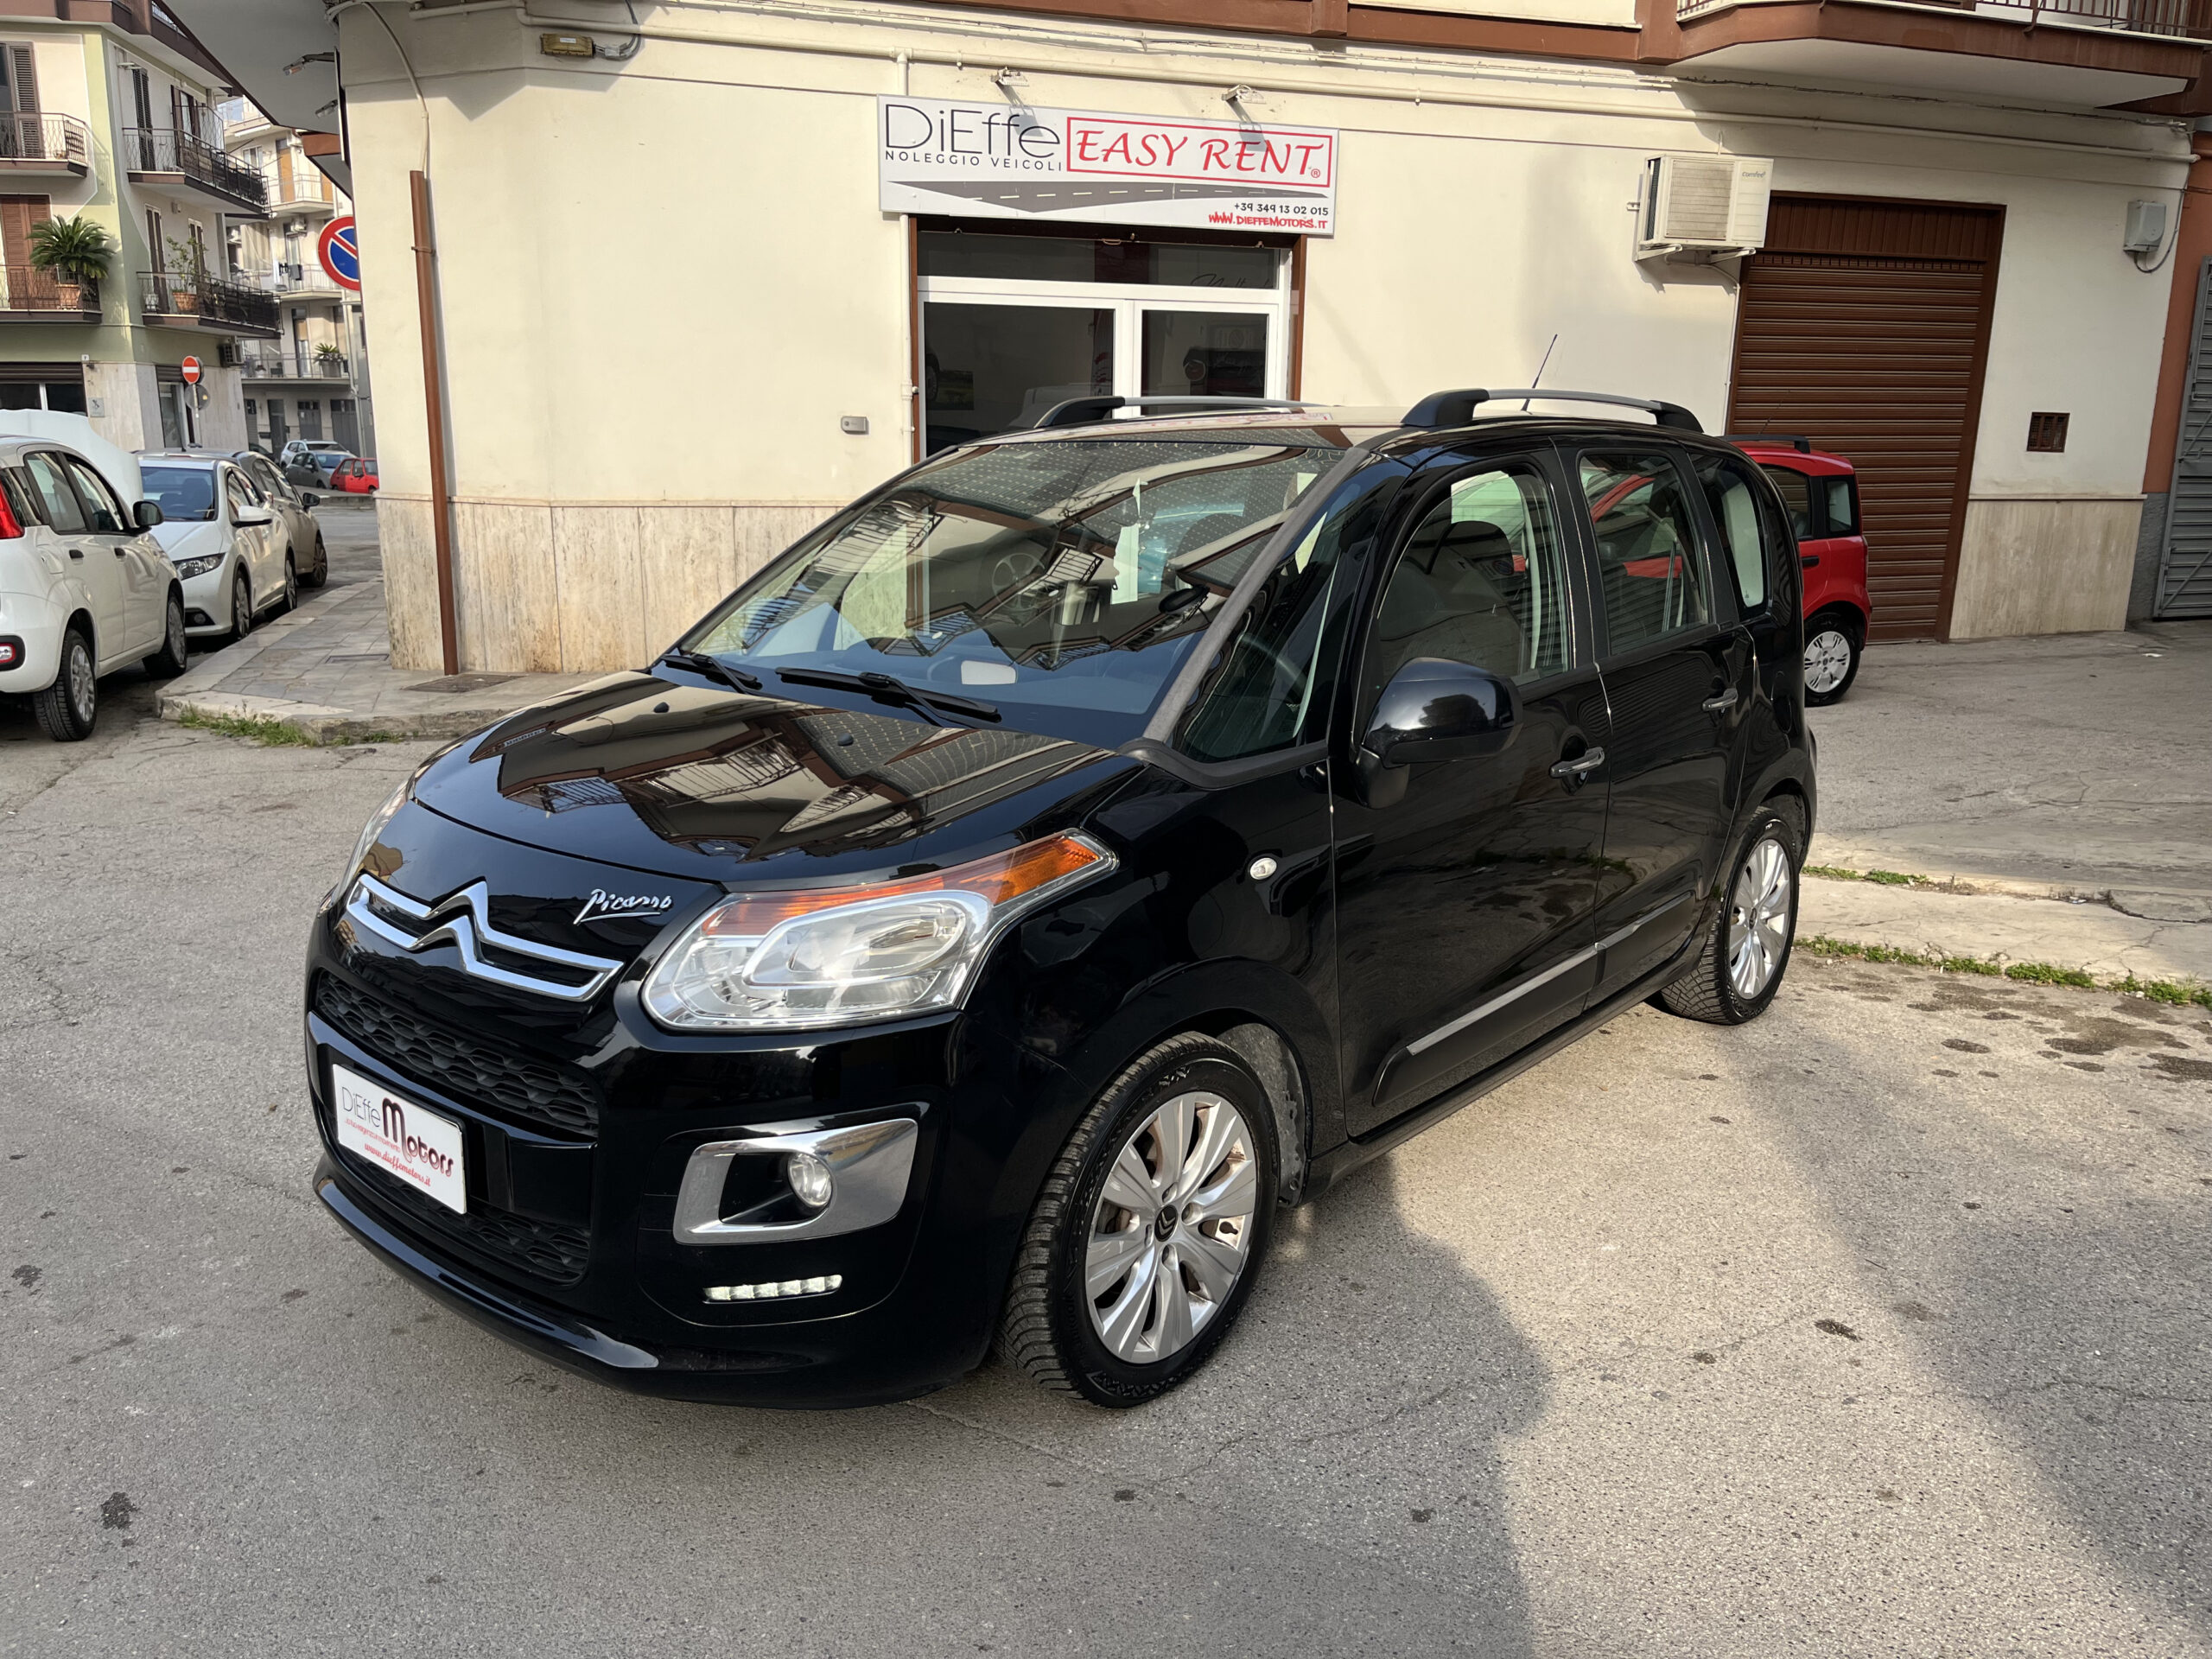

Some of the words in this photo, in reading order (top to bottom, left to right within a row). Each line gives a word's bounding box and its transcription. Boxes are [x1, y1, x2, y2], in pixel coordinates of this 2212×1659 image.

[885, 104, 1061, 158] DiEffe
[1076, 130, 1188, 167] EASY
[885, 150, 981, 166] NOLEGGIO
[990, 157, 1062, 172] VEICOLI
[1234, 202, 1254, 213] +39
[1256, 204, 1276, 213] 349
[1279, 205, 1290, 214] 13
[1294, 206, 1307, 215] 02
[1310, 207, 1329, 216] 015
[573, 888, 672, 925] Picasso
